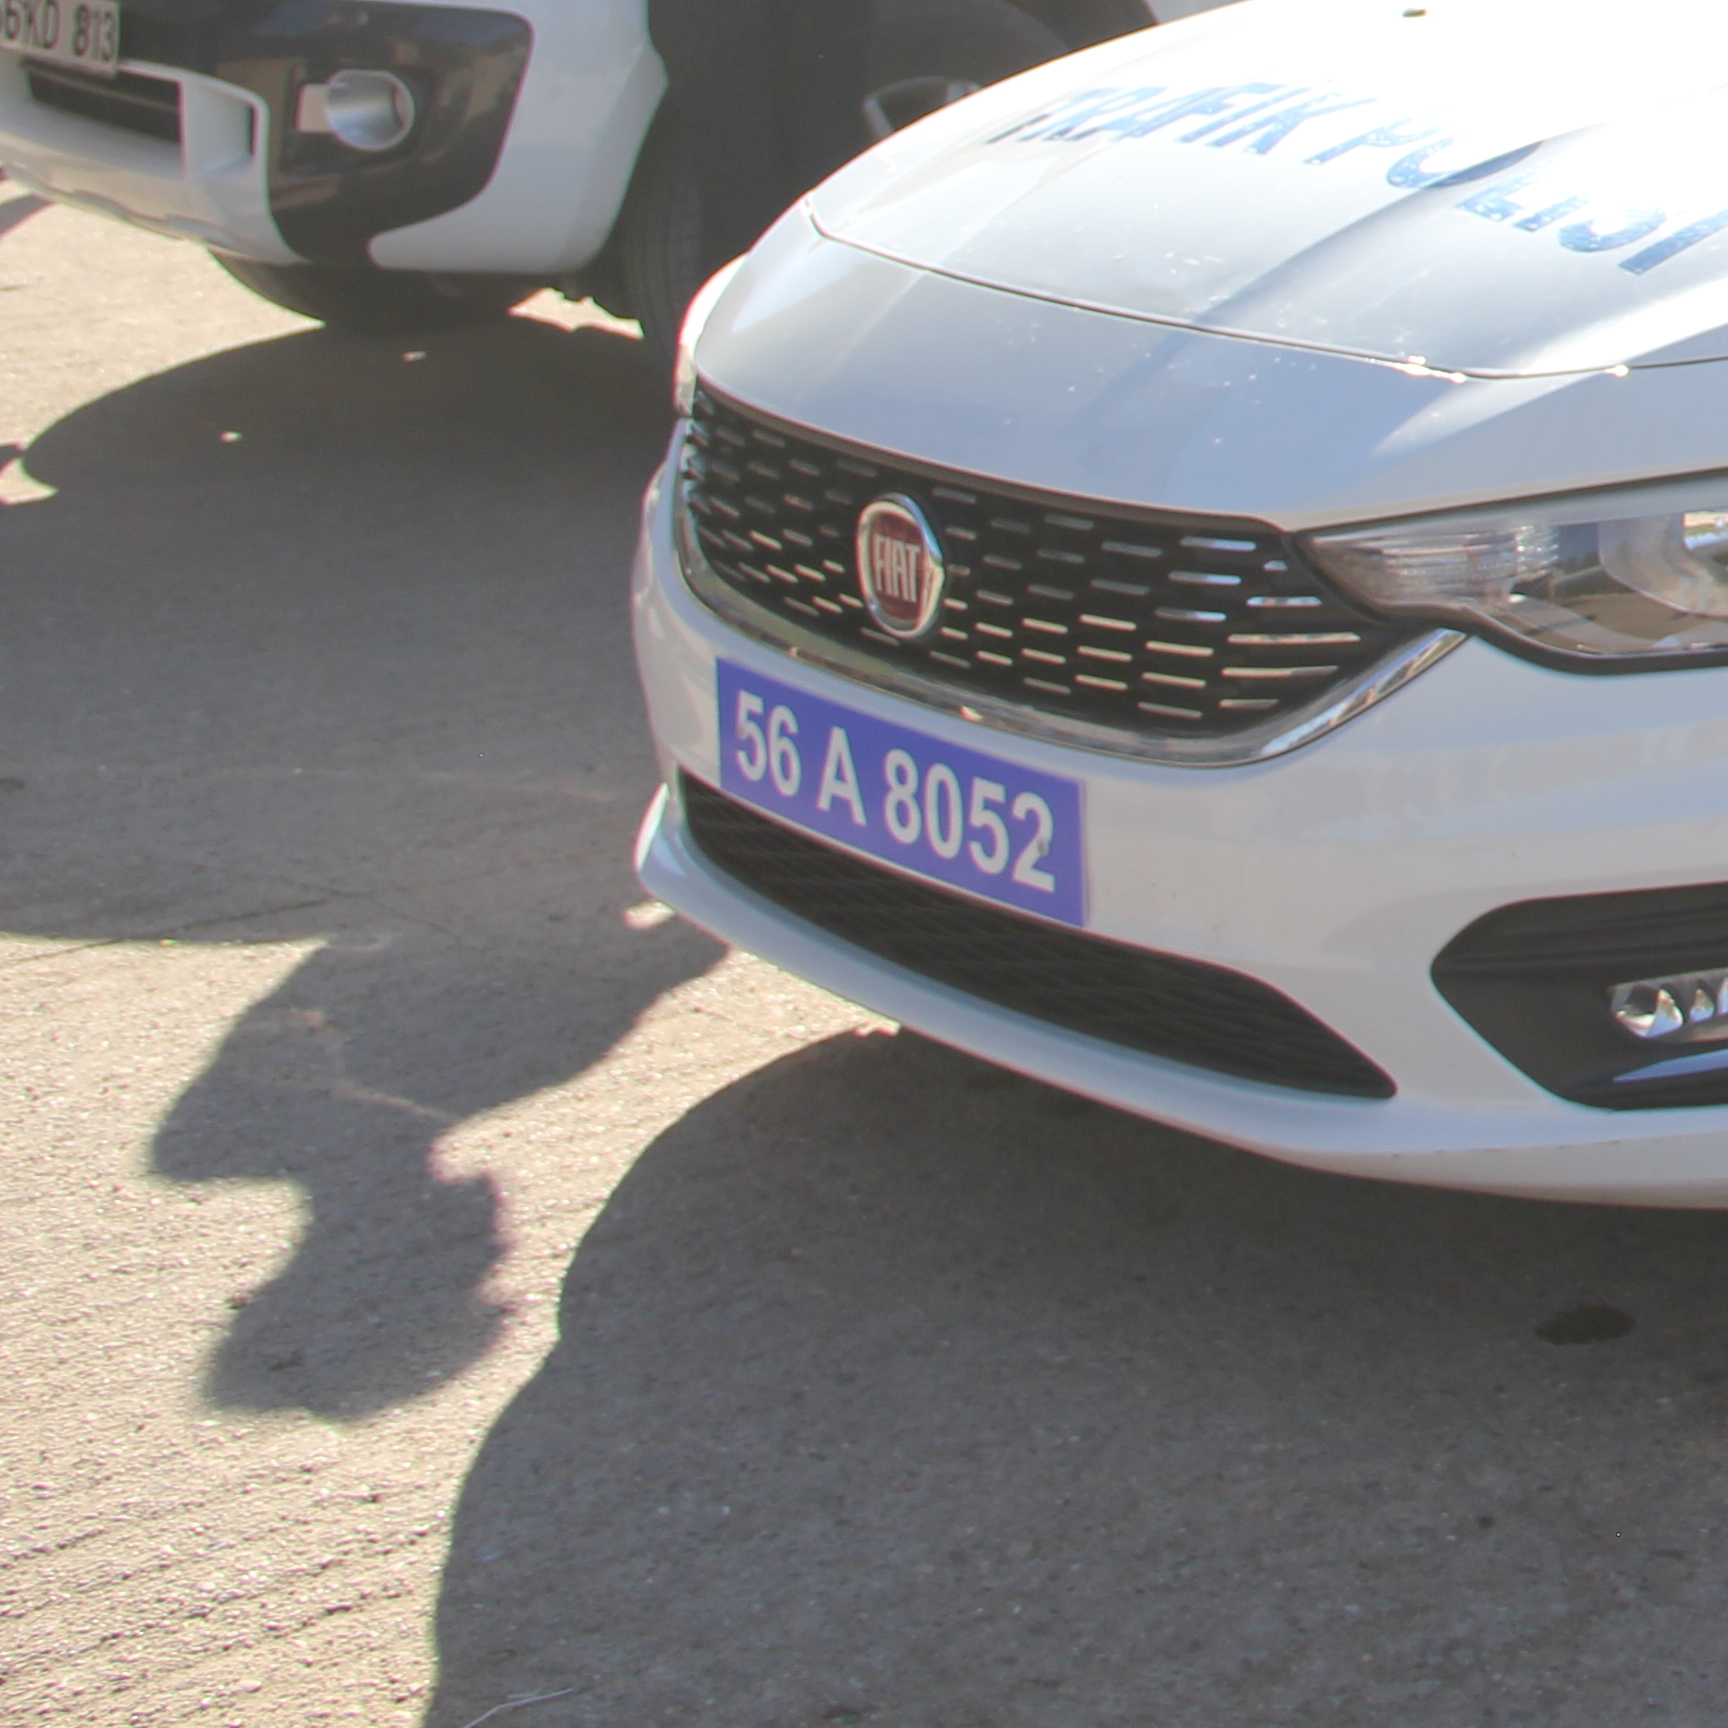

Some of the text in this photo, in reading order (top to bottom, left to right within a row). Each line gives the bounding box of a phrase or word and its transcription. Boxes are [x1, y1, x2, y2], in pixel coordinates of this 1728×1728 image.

[873, 534, 921, 603] FIAT
[736, 690, 1056, 893] 56 A 8052
